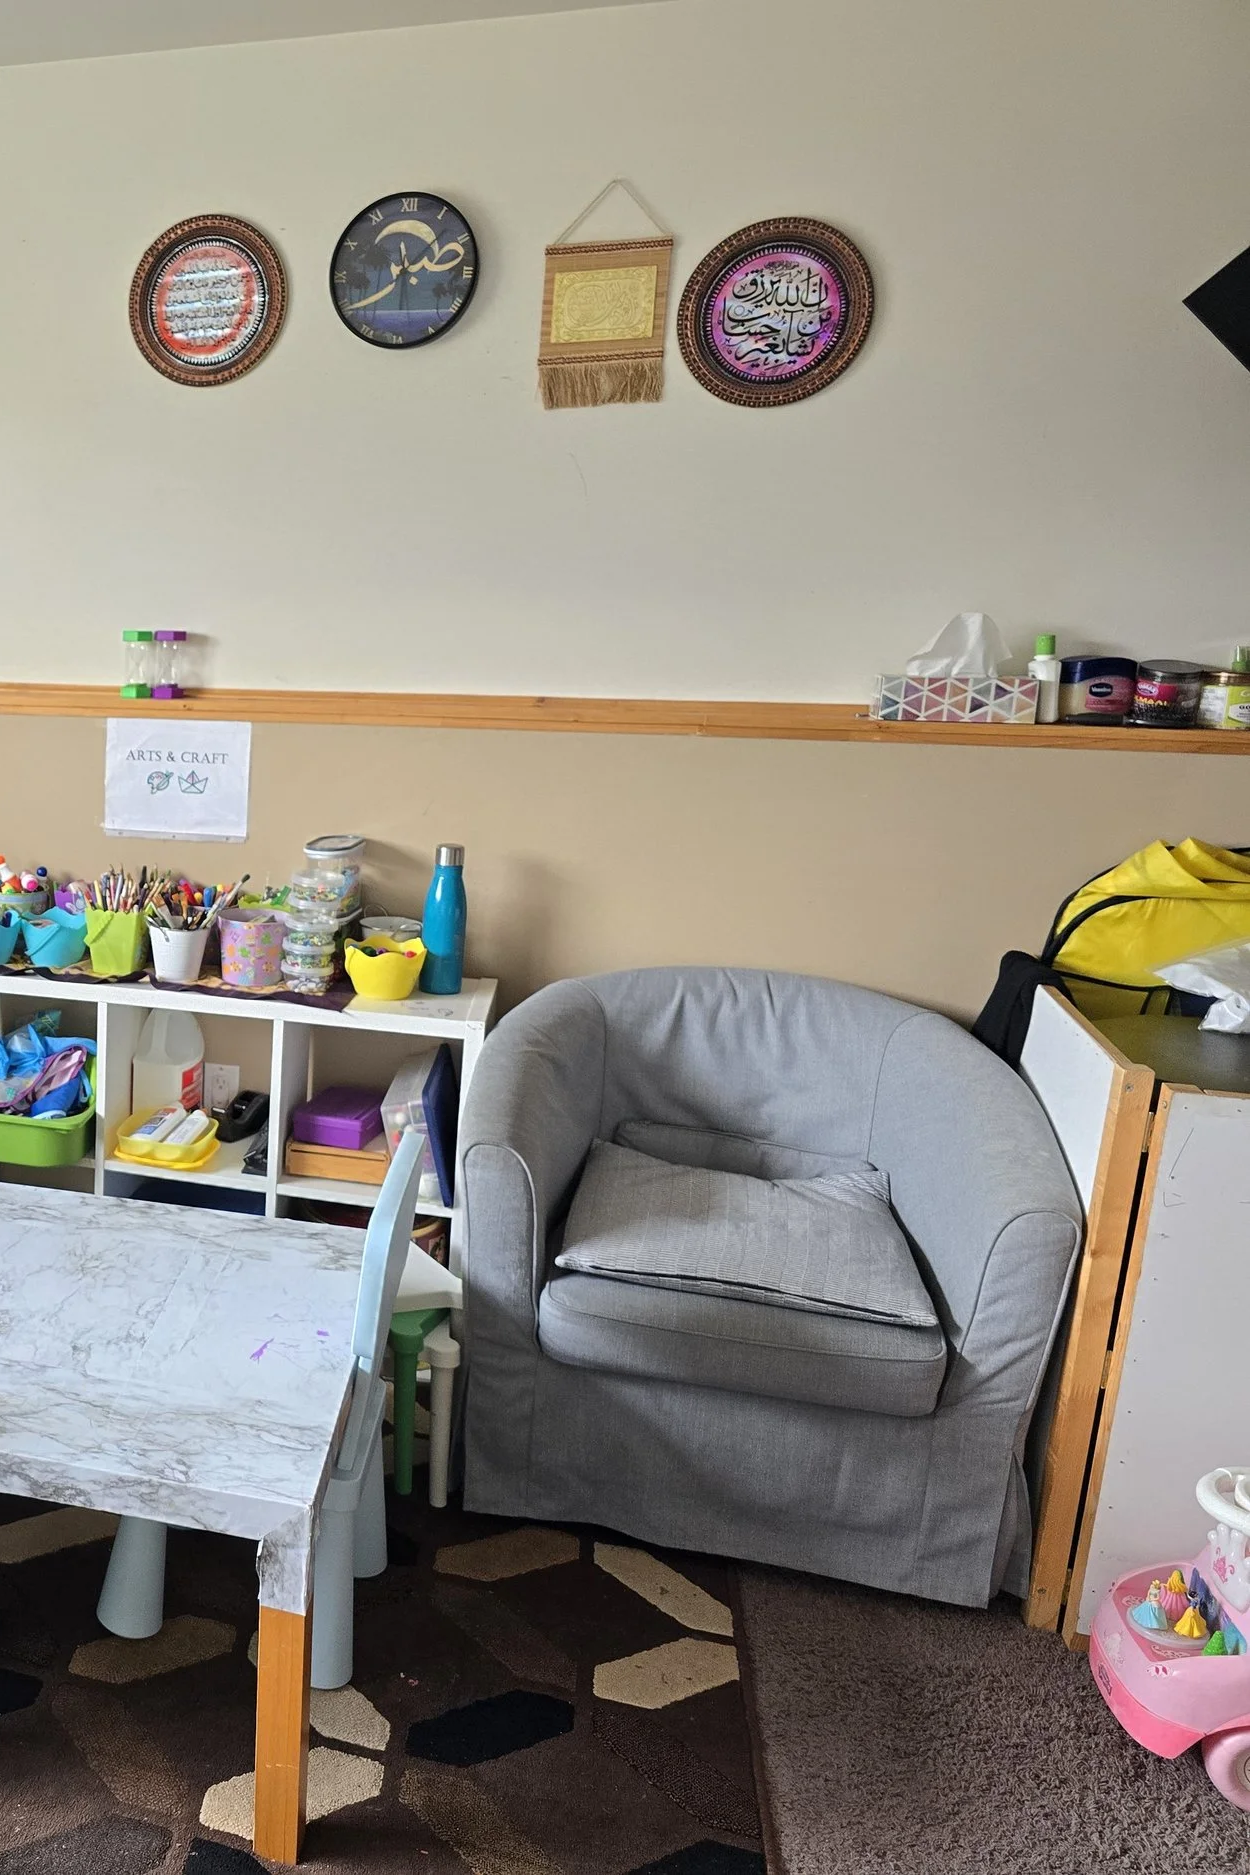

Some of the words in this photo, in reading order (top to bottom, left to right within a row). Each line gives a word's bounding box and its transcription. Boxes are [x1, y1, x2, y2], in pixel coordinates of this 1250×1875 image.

[400, 197, 418, 212] XII
[369, 209, 383, 225] XI
[437, 206, 447, 220] I
[344, 238, 358, 251] X
[457, 233, 469, 244] II
[462, 265, 474, 279] III
[125, 749, 162, 762] ARTS
[166, 751, 176, 762] &
[180, 751, 229, 765] CRAFT
